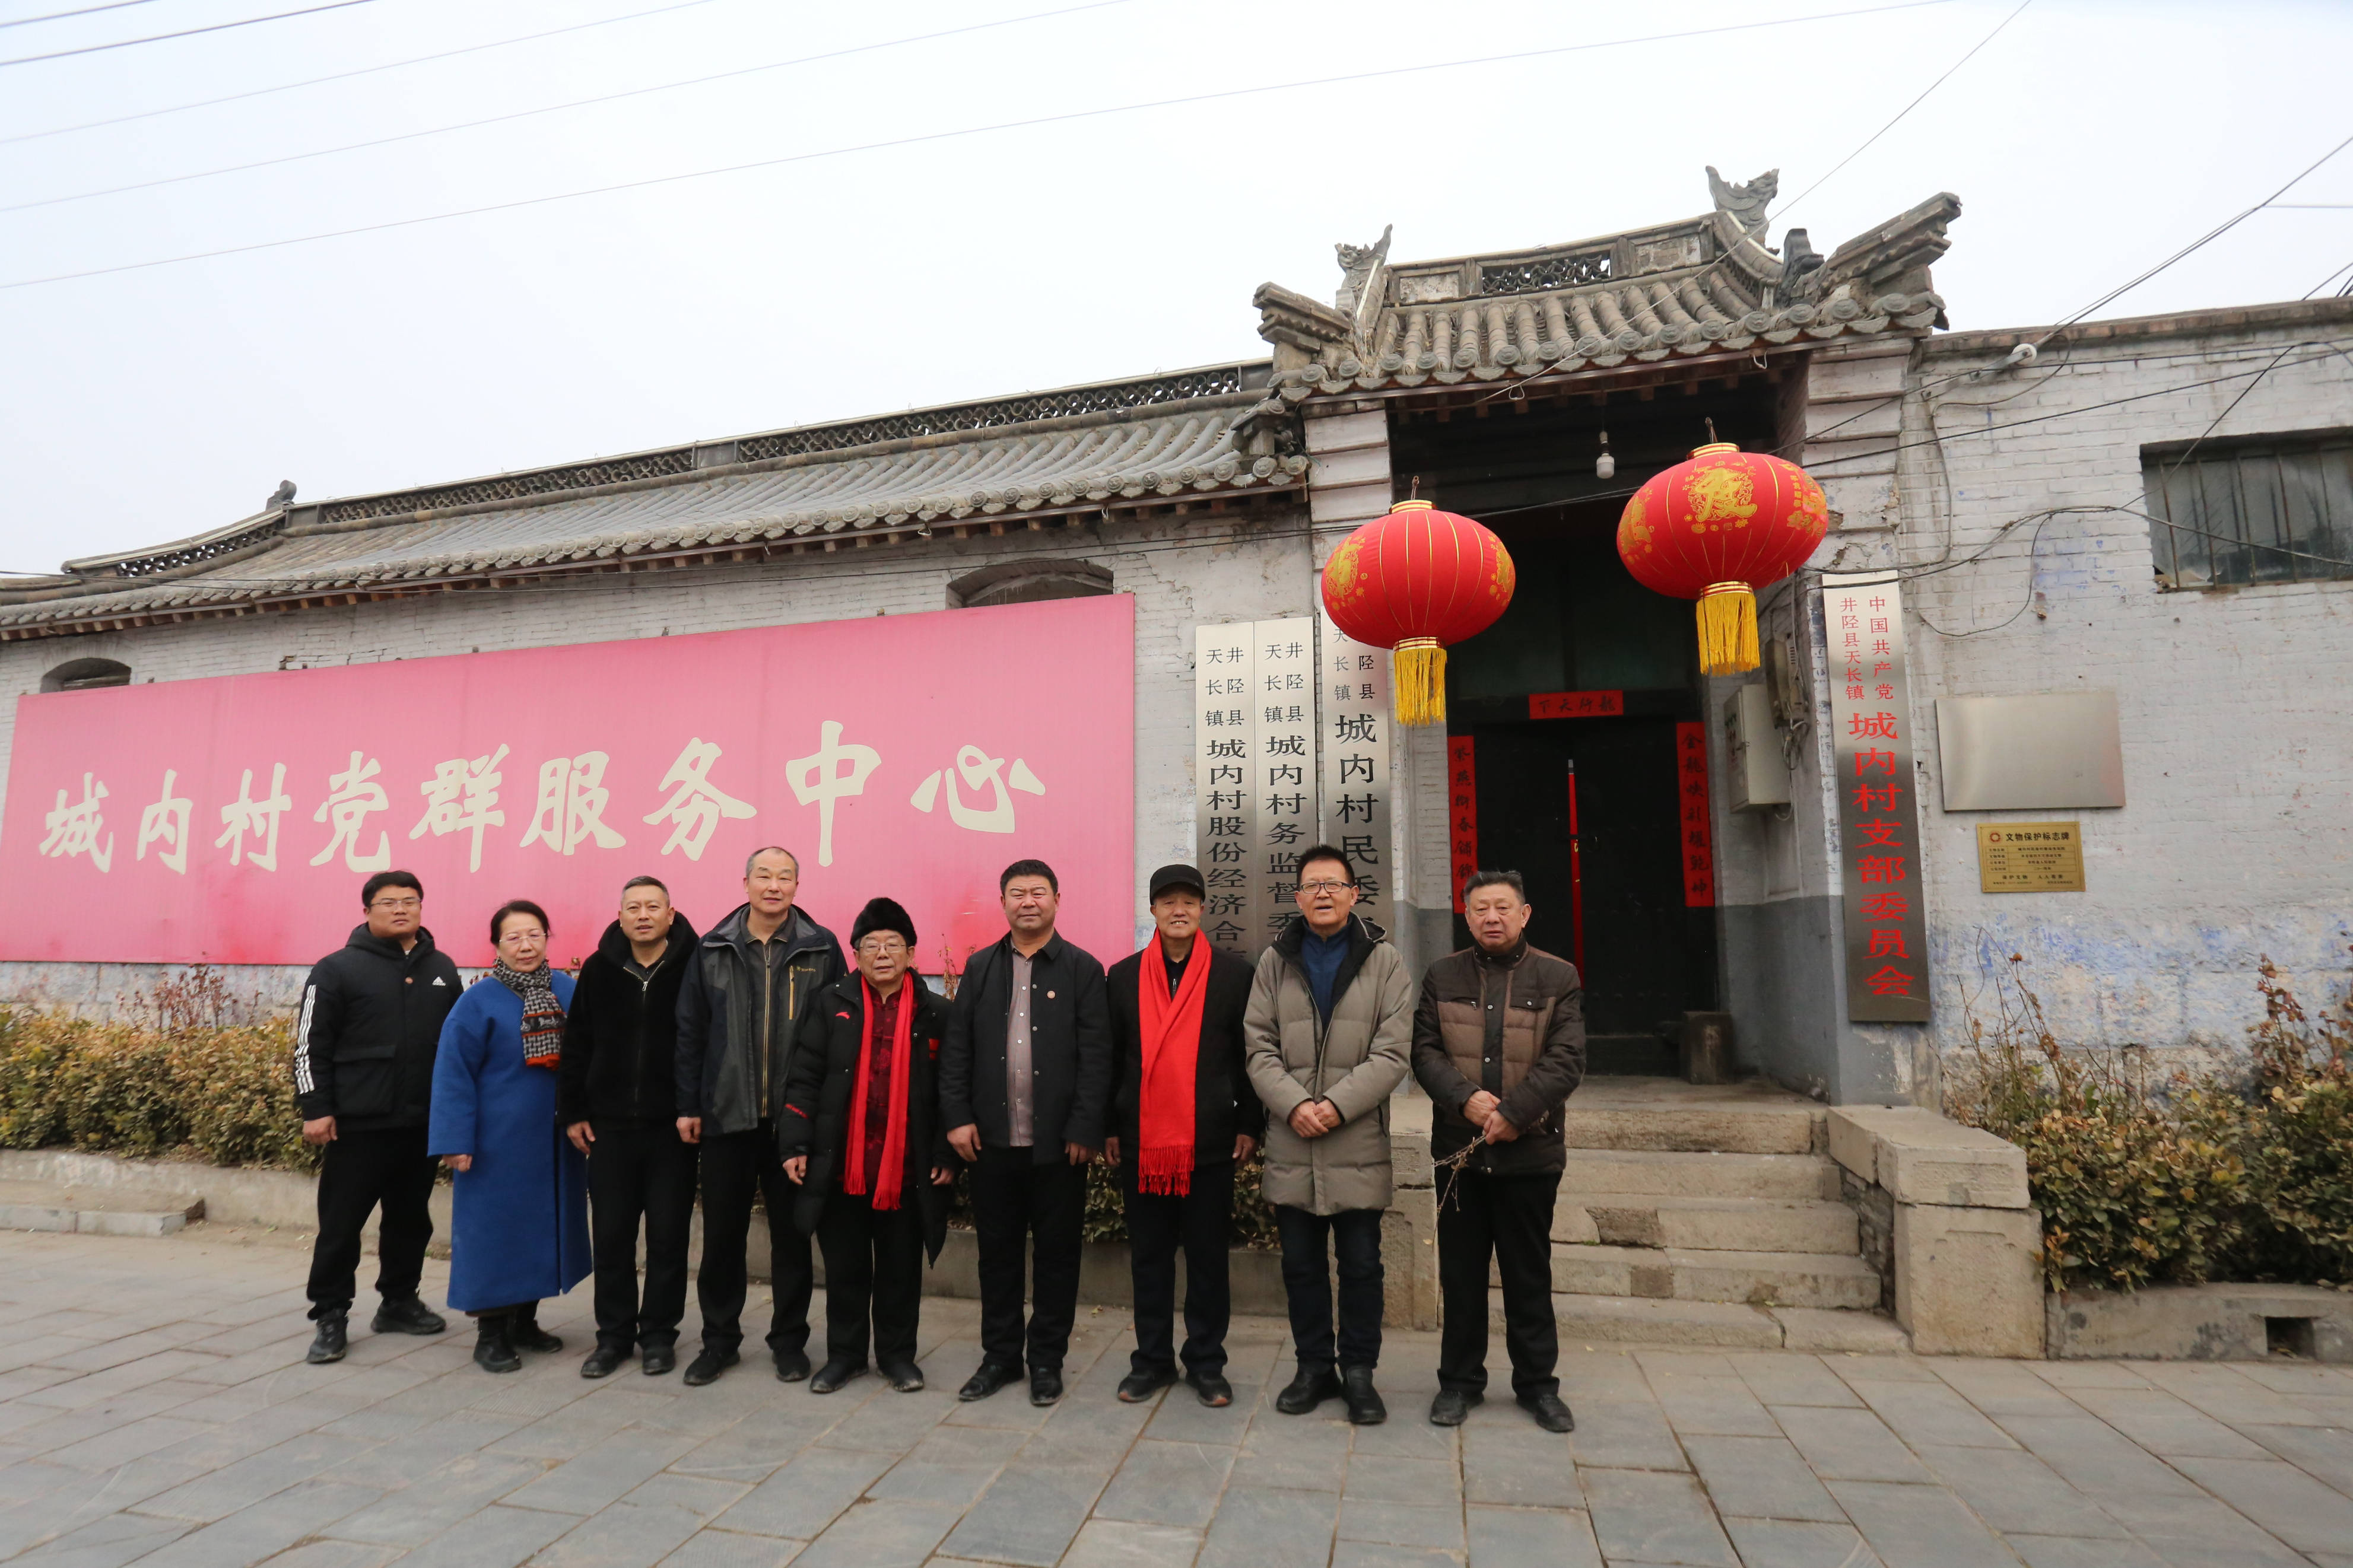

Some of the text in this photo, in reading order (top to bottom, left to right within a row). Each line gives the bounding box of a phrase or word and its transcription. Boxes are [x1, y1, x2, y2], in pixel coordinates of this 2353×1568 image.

[1205, 649, 1224, 727] 天长镇
[1226, 647, 1244, 726] 井陉县
[1264, 644, 1283, 723] 天长镇
[1285, 642, 1304, 722] 井陉县
[1333, 628, 1351, 701] 天长镇
[1359, 655, 1376, 699] 陉县
[1840, 597, 1865, 701] 井陉县天长镇
[1869, 596, 1894, 700] 中国共产党
[39, 720, 1046, 874] 城内村党群服务中心
[1335, 714, 1380, 922] 城内村民委
[2006, 832, 2070, 842] 文物保护标志牌
[1206, 739, 1247, 958] 城内村股份经济合
[1848, 711, 1914, 995] 城内村支部委员会
